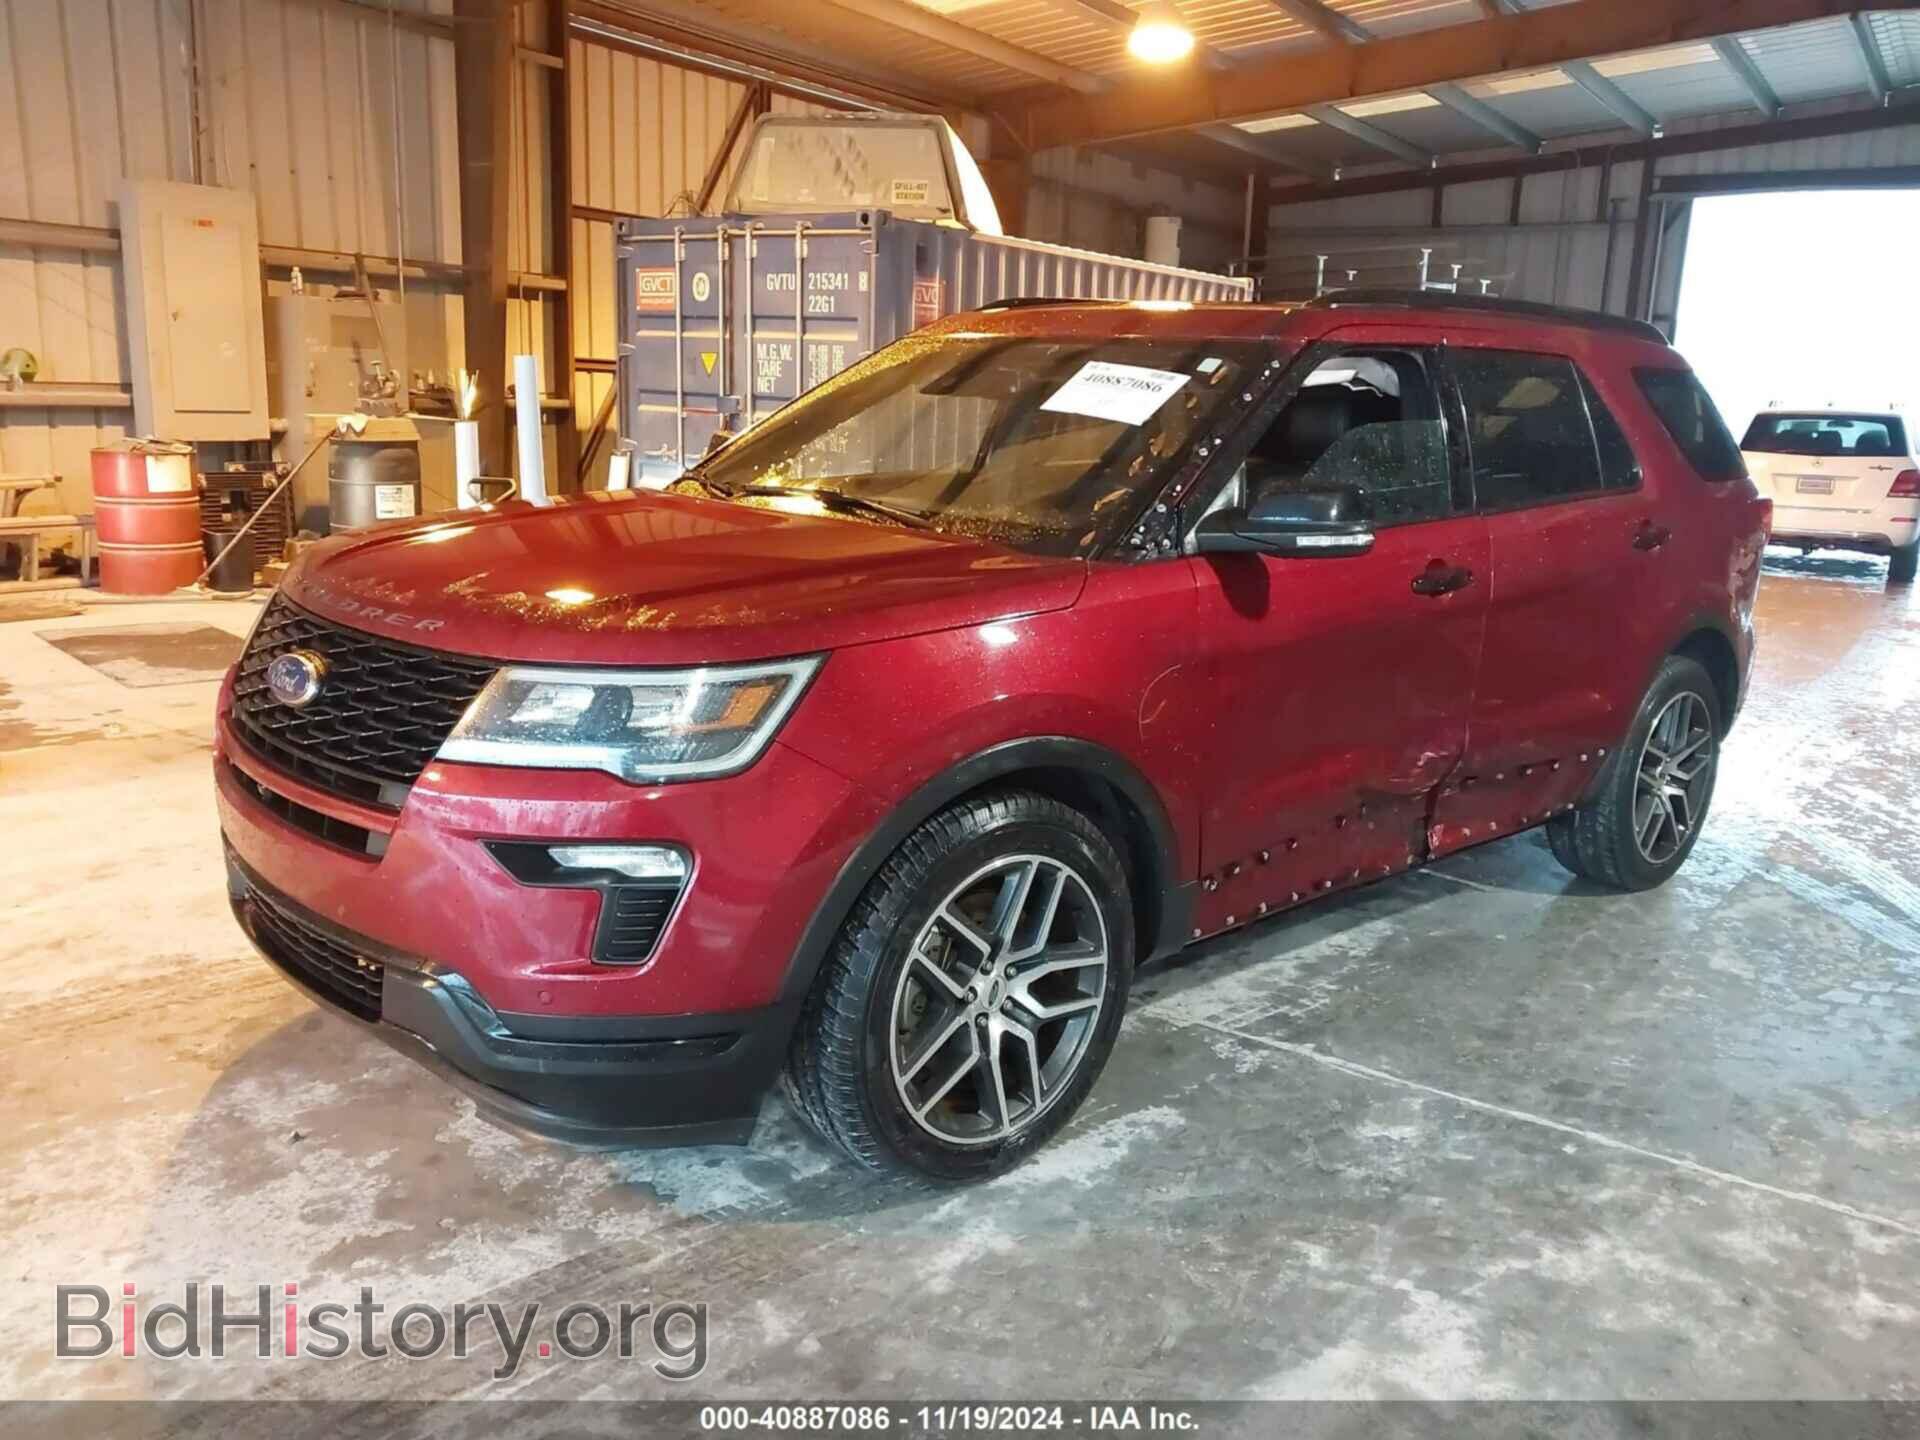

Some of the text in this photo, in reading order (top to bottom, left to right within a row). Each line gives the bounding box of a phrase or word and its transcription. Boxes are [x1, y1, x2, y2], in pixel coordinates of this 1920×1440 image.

[766, 272, 796, 291] GVTU
[807, 272, 849, 291] 215341
[807, 294, 836, 313] 22G1
[756, 343, 793, 361] M.G.W.
[758, 360, 783, 377] TARE
[757, 377, 776, 393] NET
[271, 660, 301, 692] Ford
